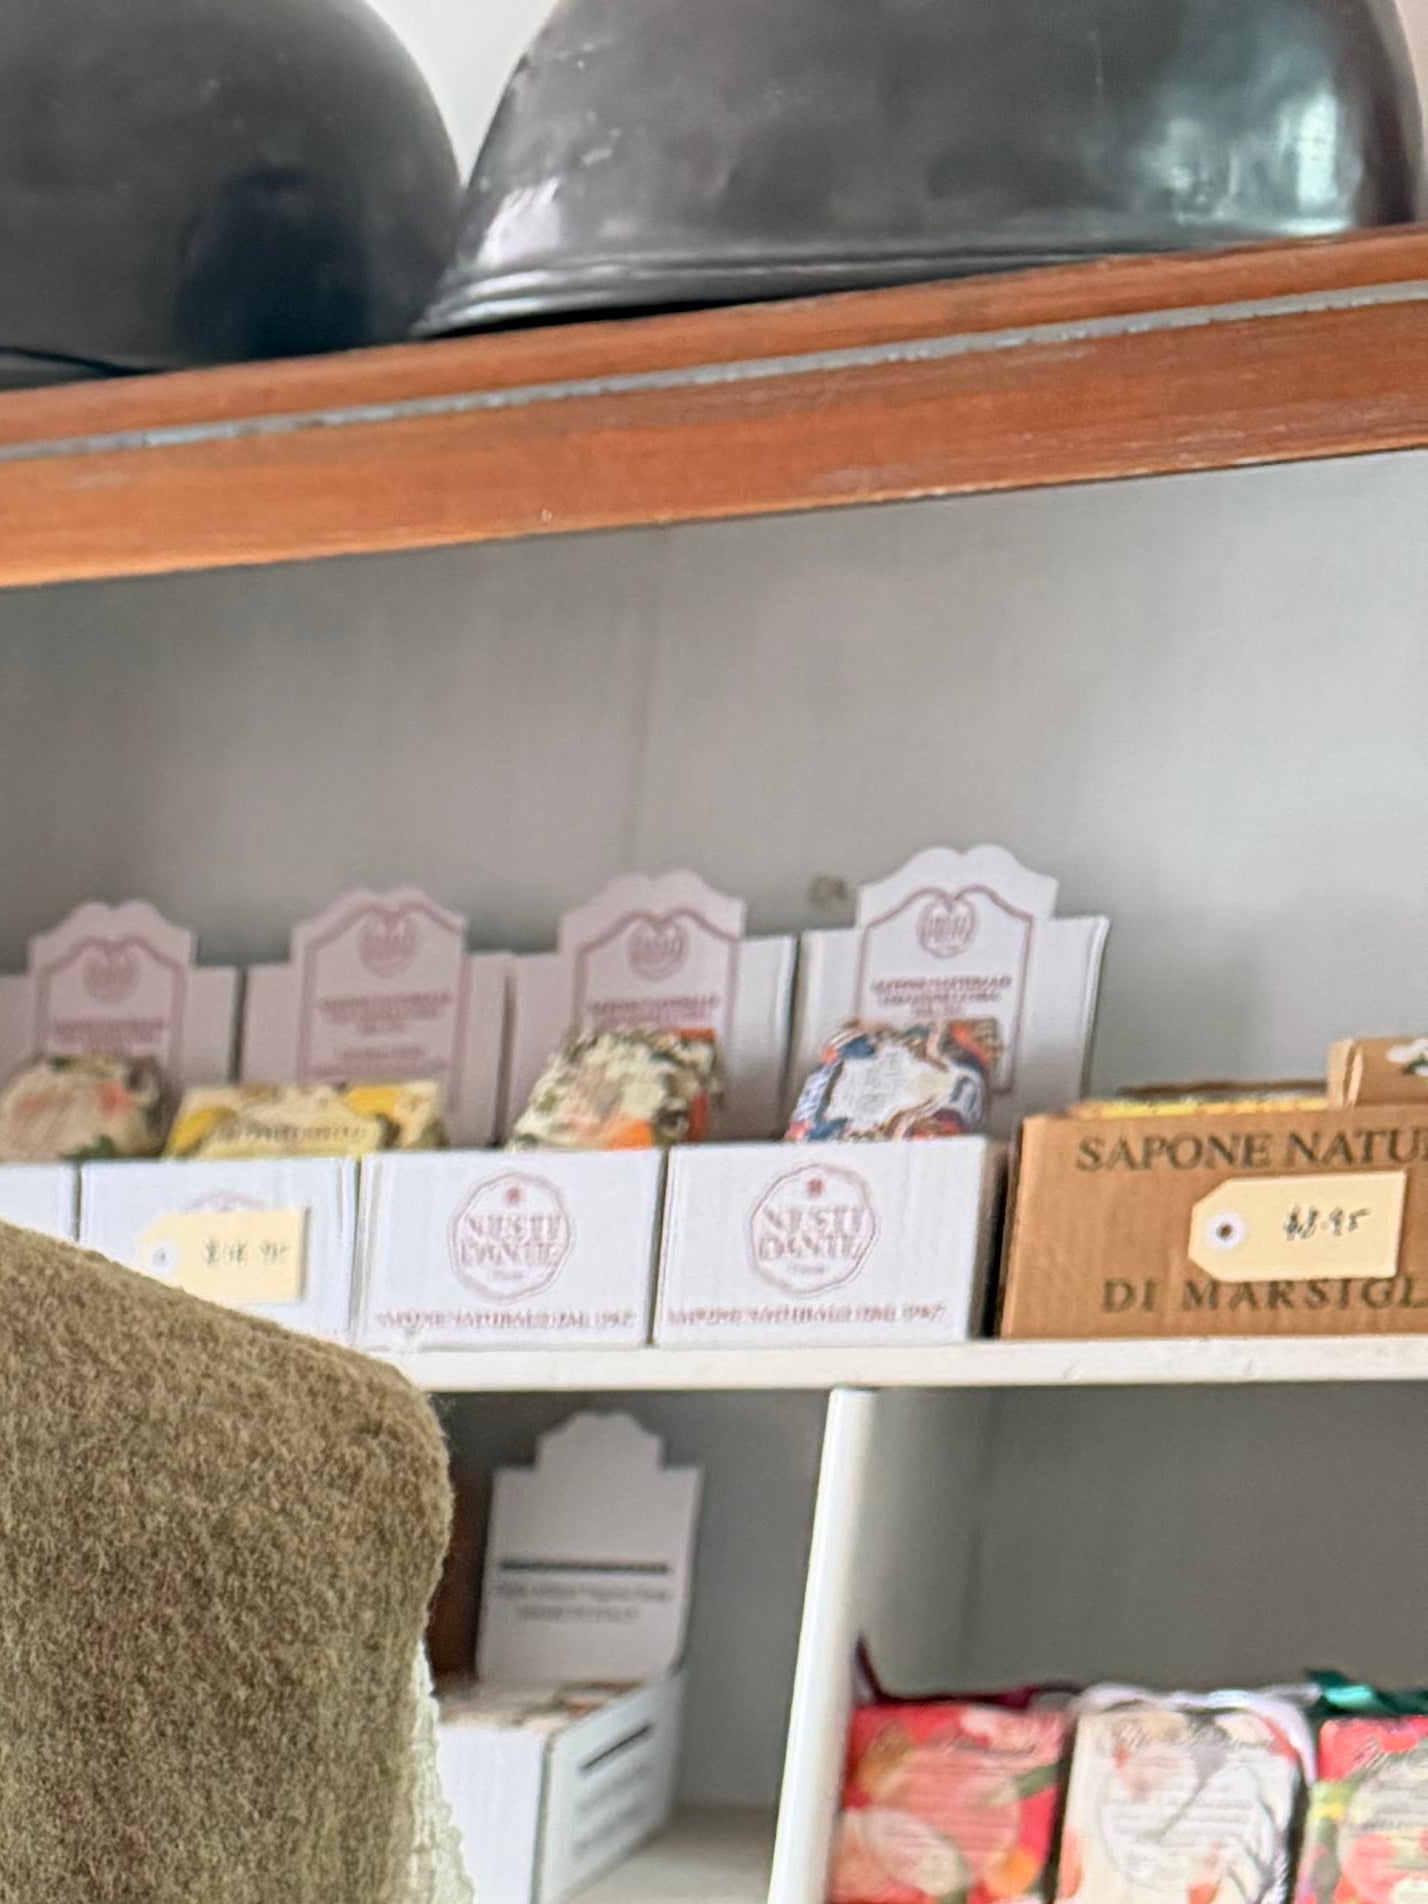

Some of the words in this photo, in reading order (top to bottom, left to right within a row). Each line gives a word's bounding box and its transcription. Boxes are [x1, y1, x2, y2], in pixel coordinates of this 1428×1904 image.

[1075, 1131, 1271, 1173] SAPONE
[1284, 1125, 1428, 1168] NATU
[1101, 1277, 1157, 1314] DI
